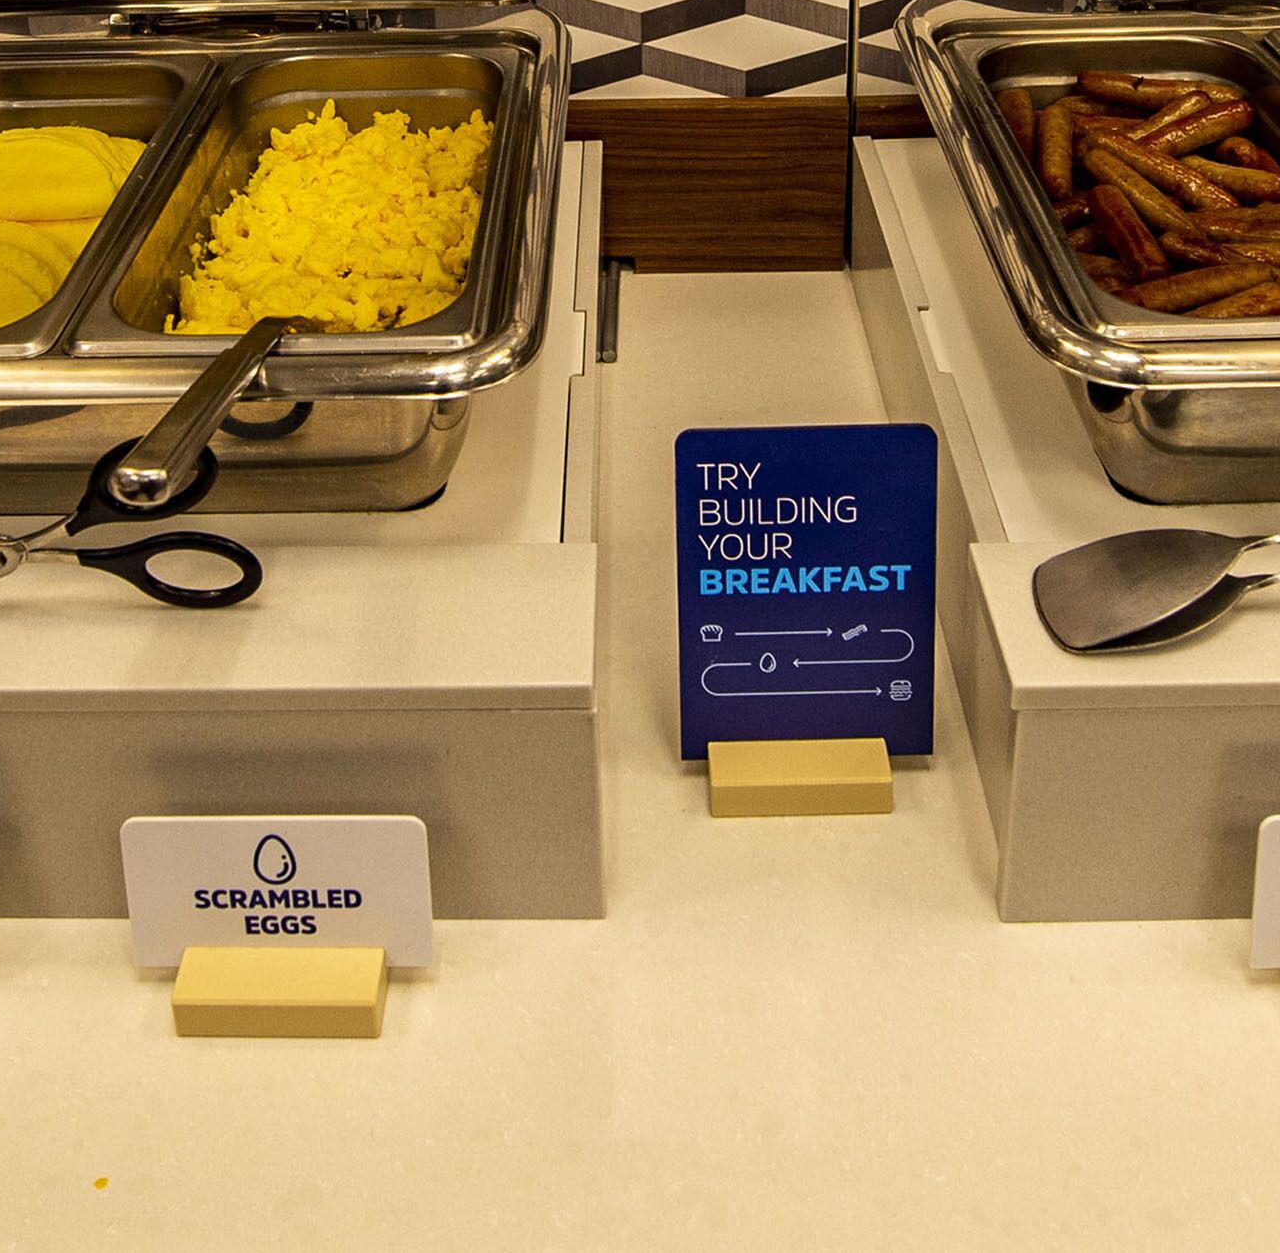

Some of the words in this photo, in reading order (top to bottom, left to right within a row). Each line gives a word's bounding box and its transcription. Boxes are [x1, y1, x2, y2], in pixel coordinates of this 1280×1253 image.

[696, 462, 761, 491] TRY
[699, 495, 858, 527] BUILDING
[698, 532, 793, 561] YOUR
[699, 564, 912, 595] BREAKFAST
[194, 888, 363, 910] SCRAMBLED
[244, 915, 318, 936] EGGS
